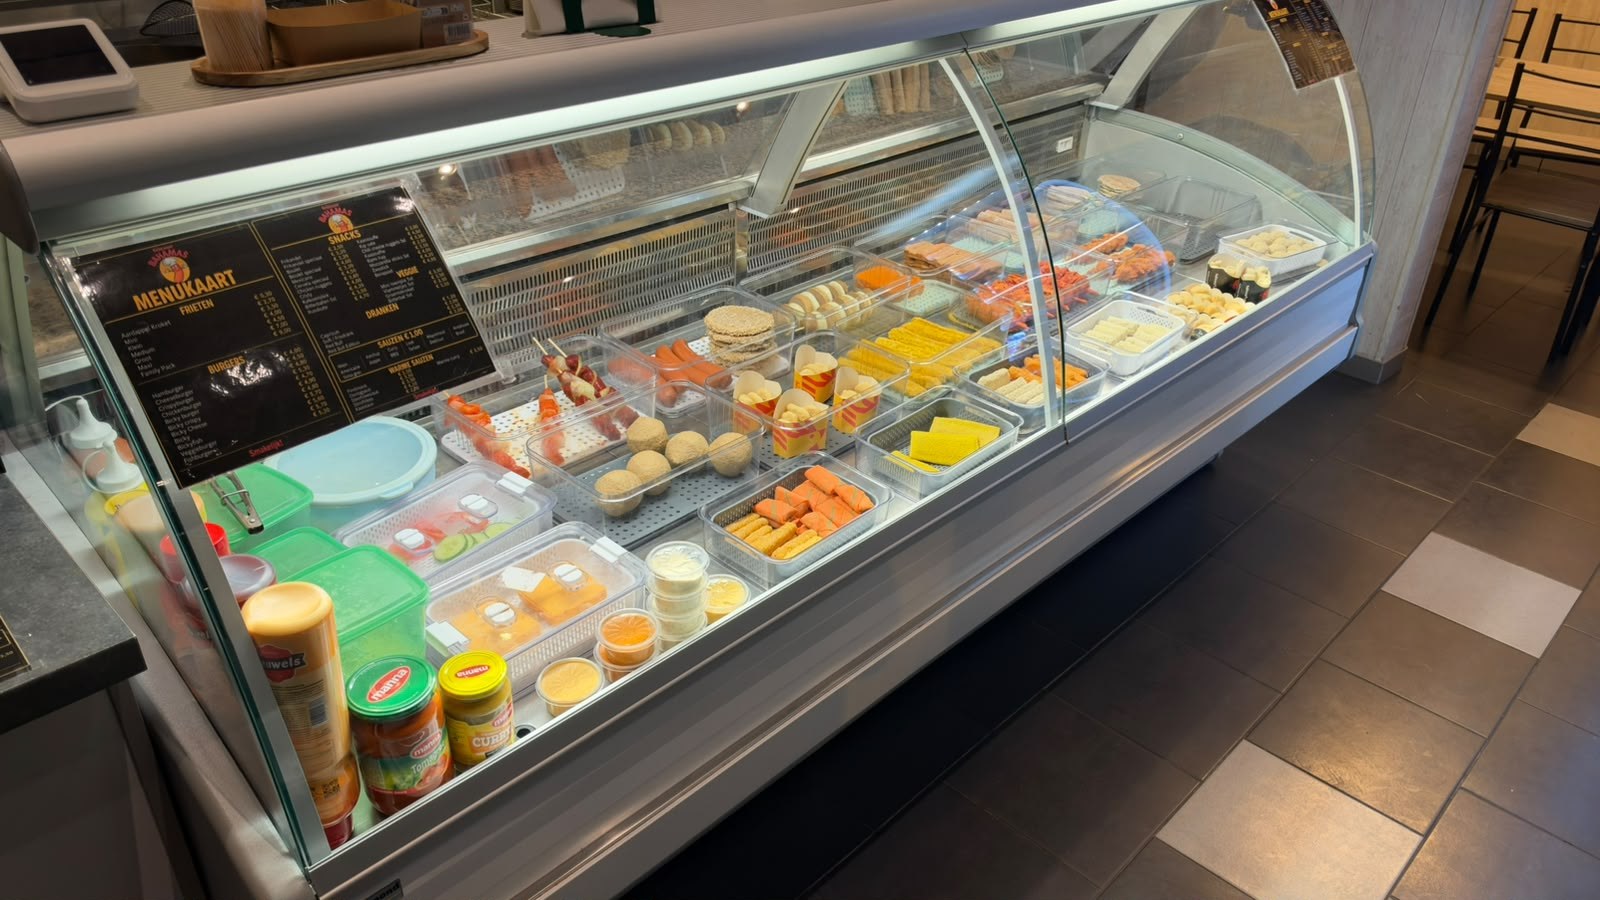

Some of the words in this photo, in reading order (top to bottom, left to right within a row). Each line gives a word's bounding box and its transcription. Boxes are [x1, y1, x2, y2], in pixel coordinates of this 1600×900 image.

[319, 208, 352, 223] BAHAMAS
[328, 230, 361, 244] SNACKS
[147, 249, 189, 268] BAHAMAS
[396, 266, 418, 277] VEGGIE
[132, 270, 237, 311] MENUKAART
[179, 299, 215, 316] FRIETEN
[366, 303, 399, 318] DRANKEN
[150, 320, 171, 329] Kroket
[377, 335, 404, 348] SAUZEN
[408, 328, 423, 338] 1,00
[130, 347, 155, 357] Medium
[134, 355, 152, 364] Groot
[137, 362, 152, 370] Maxi
[207, 356, 246, 374] BURGERS
[388, 361, 411, 373] WARME
[411, 354, 433, 366] SAUZEN
[140, 368, 160, 377] Family
[152, 385, 183, 398] Hamburger
[155, 390, 193, 405] Cheeseburger
[158, 396, 194, 411] Crispyburger
[161, 401, 201, 417] Chickenburger
[164, 416, 180, 424] Bicky
[180, 409, 199, 419] burger
[167, 423, 184, 431] Bicky
[184, 417, 201, 425] crispy
[170, 429, 187, 437] Bicky
[187, 422, 207, 431] Cheese
[174, 436, 190, 444] Bicky
[180, 441, 216, 456] Veggieburger
[456, 665, 489, 678] manna
[371, 668, 410, 701] manna
